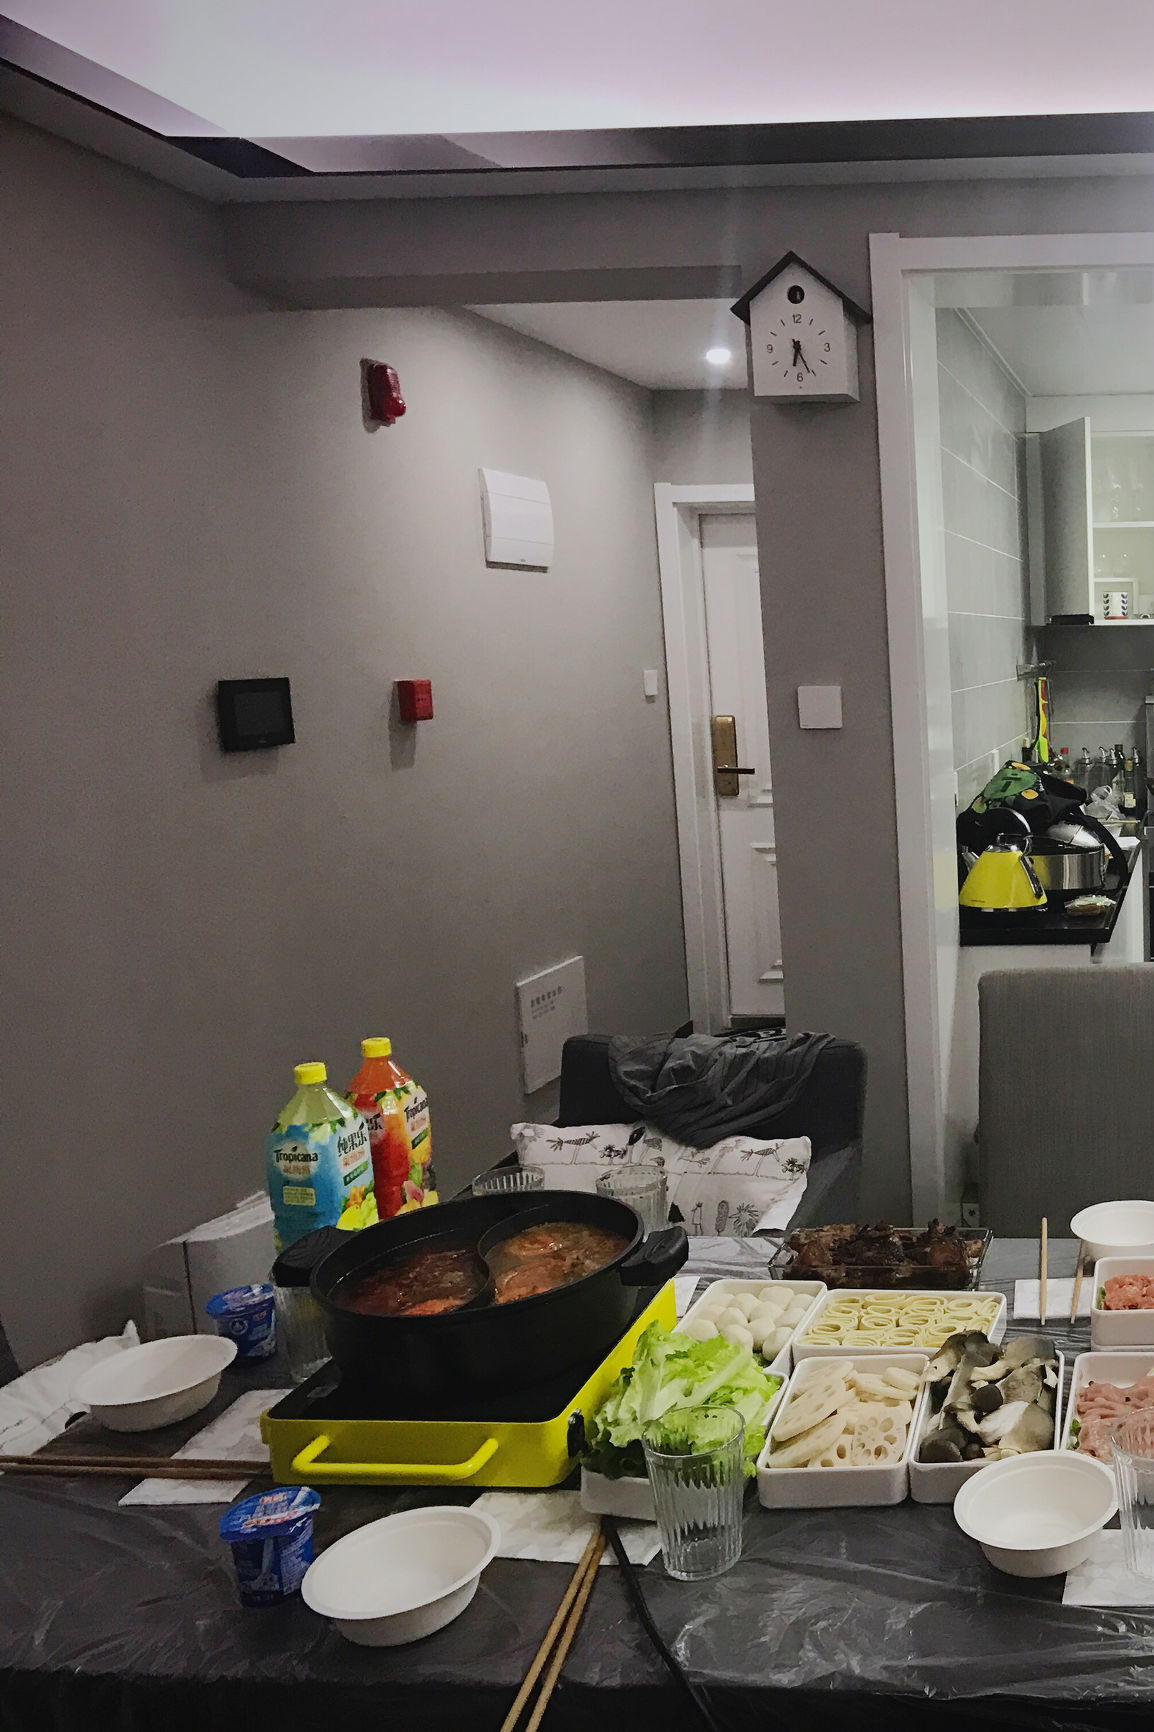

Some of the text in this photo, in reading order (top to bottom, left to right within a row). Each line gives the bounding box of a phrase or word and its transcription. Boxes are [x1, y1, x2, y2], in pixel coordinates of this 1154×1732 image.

[792, 314, 802, 324] 12
[766, 344, 773, 354] 9
[823, 342, 831, 353] 3
[796, 372, 804, 382] 6
[337, 1122, 368, 1157] 纯果乐
[273, 1146, 319, 1164] Tropicana
